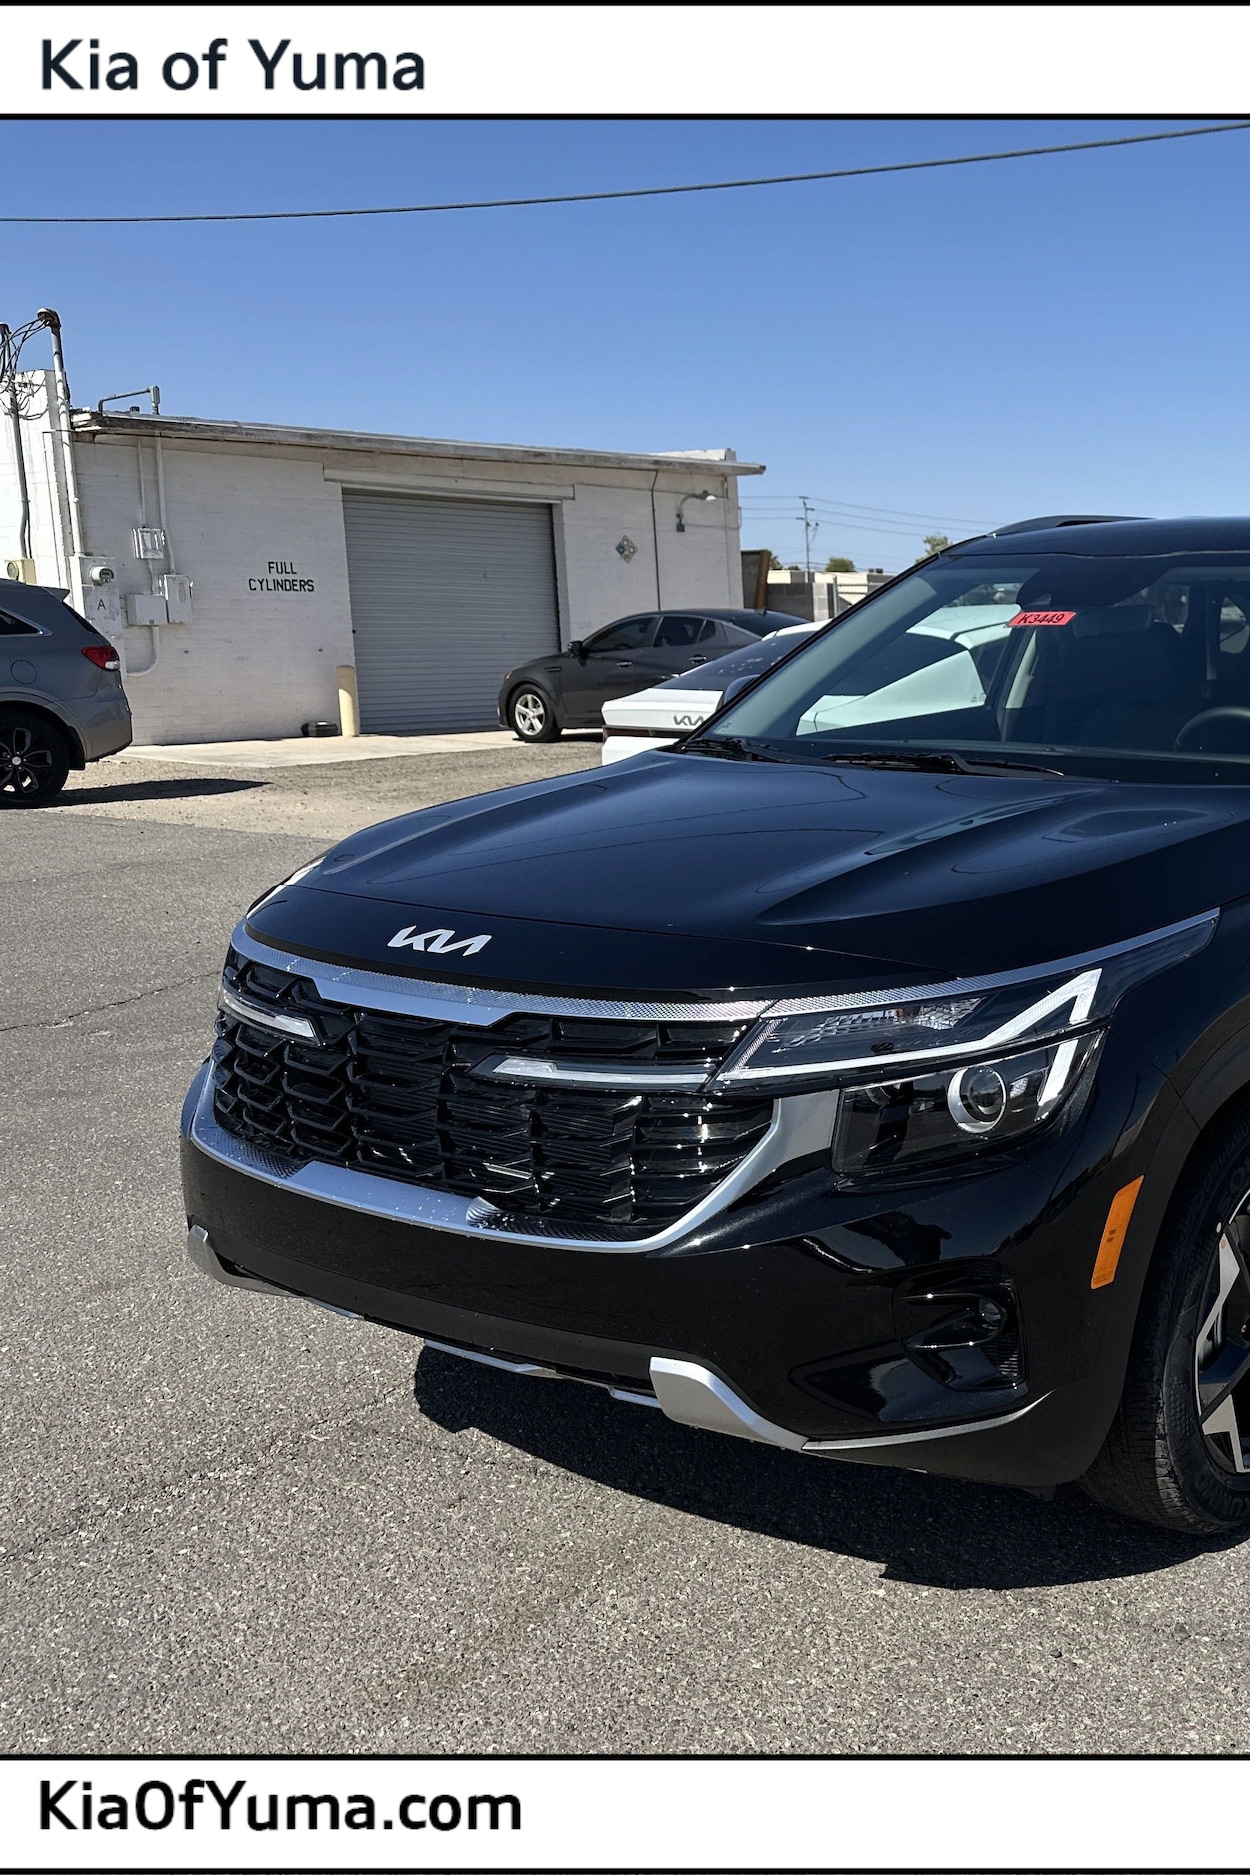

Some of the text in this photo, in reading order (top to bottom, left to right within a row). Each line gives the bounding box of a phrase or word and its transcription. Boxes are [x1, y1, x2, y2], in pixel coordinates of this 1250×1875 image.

[267, 561, 297, 574] FULL
[248, 578, 315, 592] CYLINDERS
[97, 598, 106, 611] A
[1017, 613, 1065, 624] K3449
[387, 925, 492, 957] KIA
